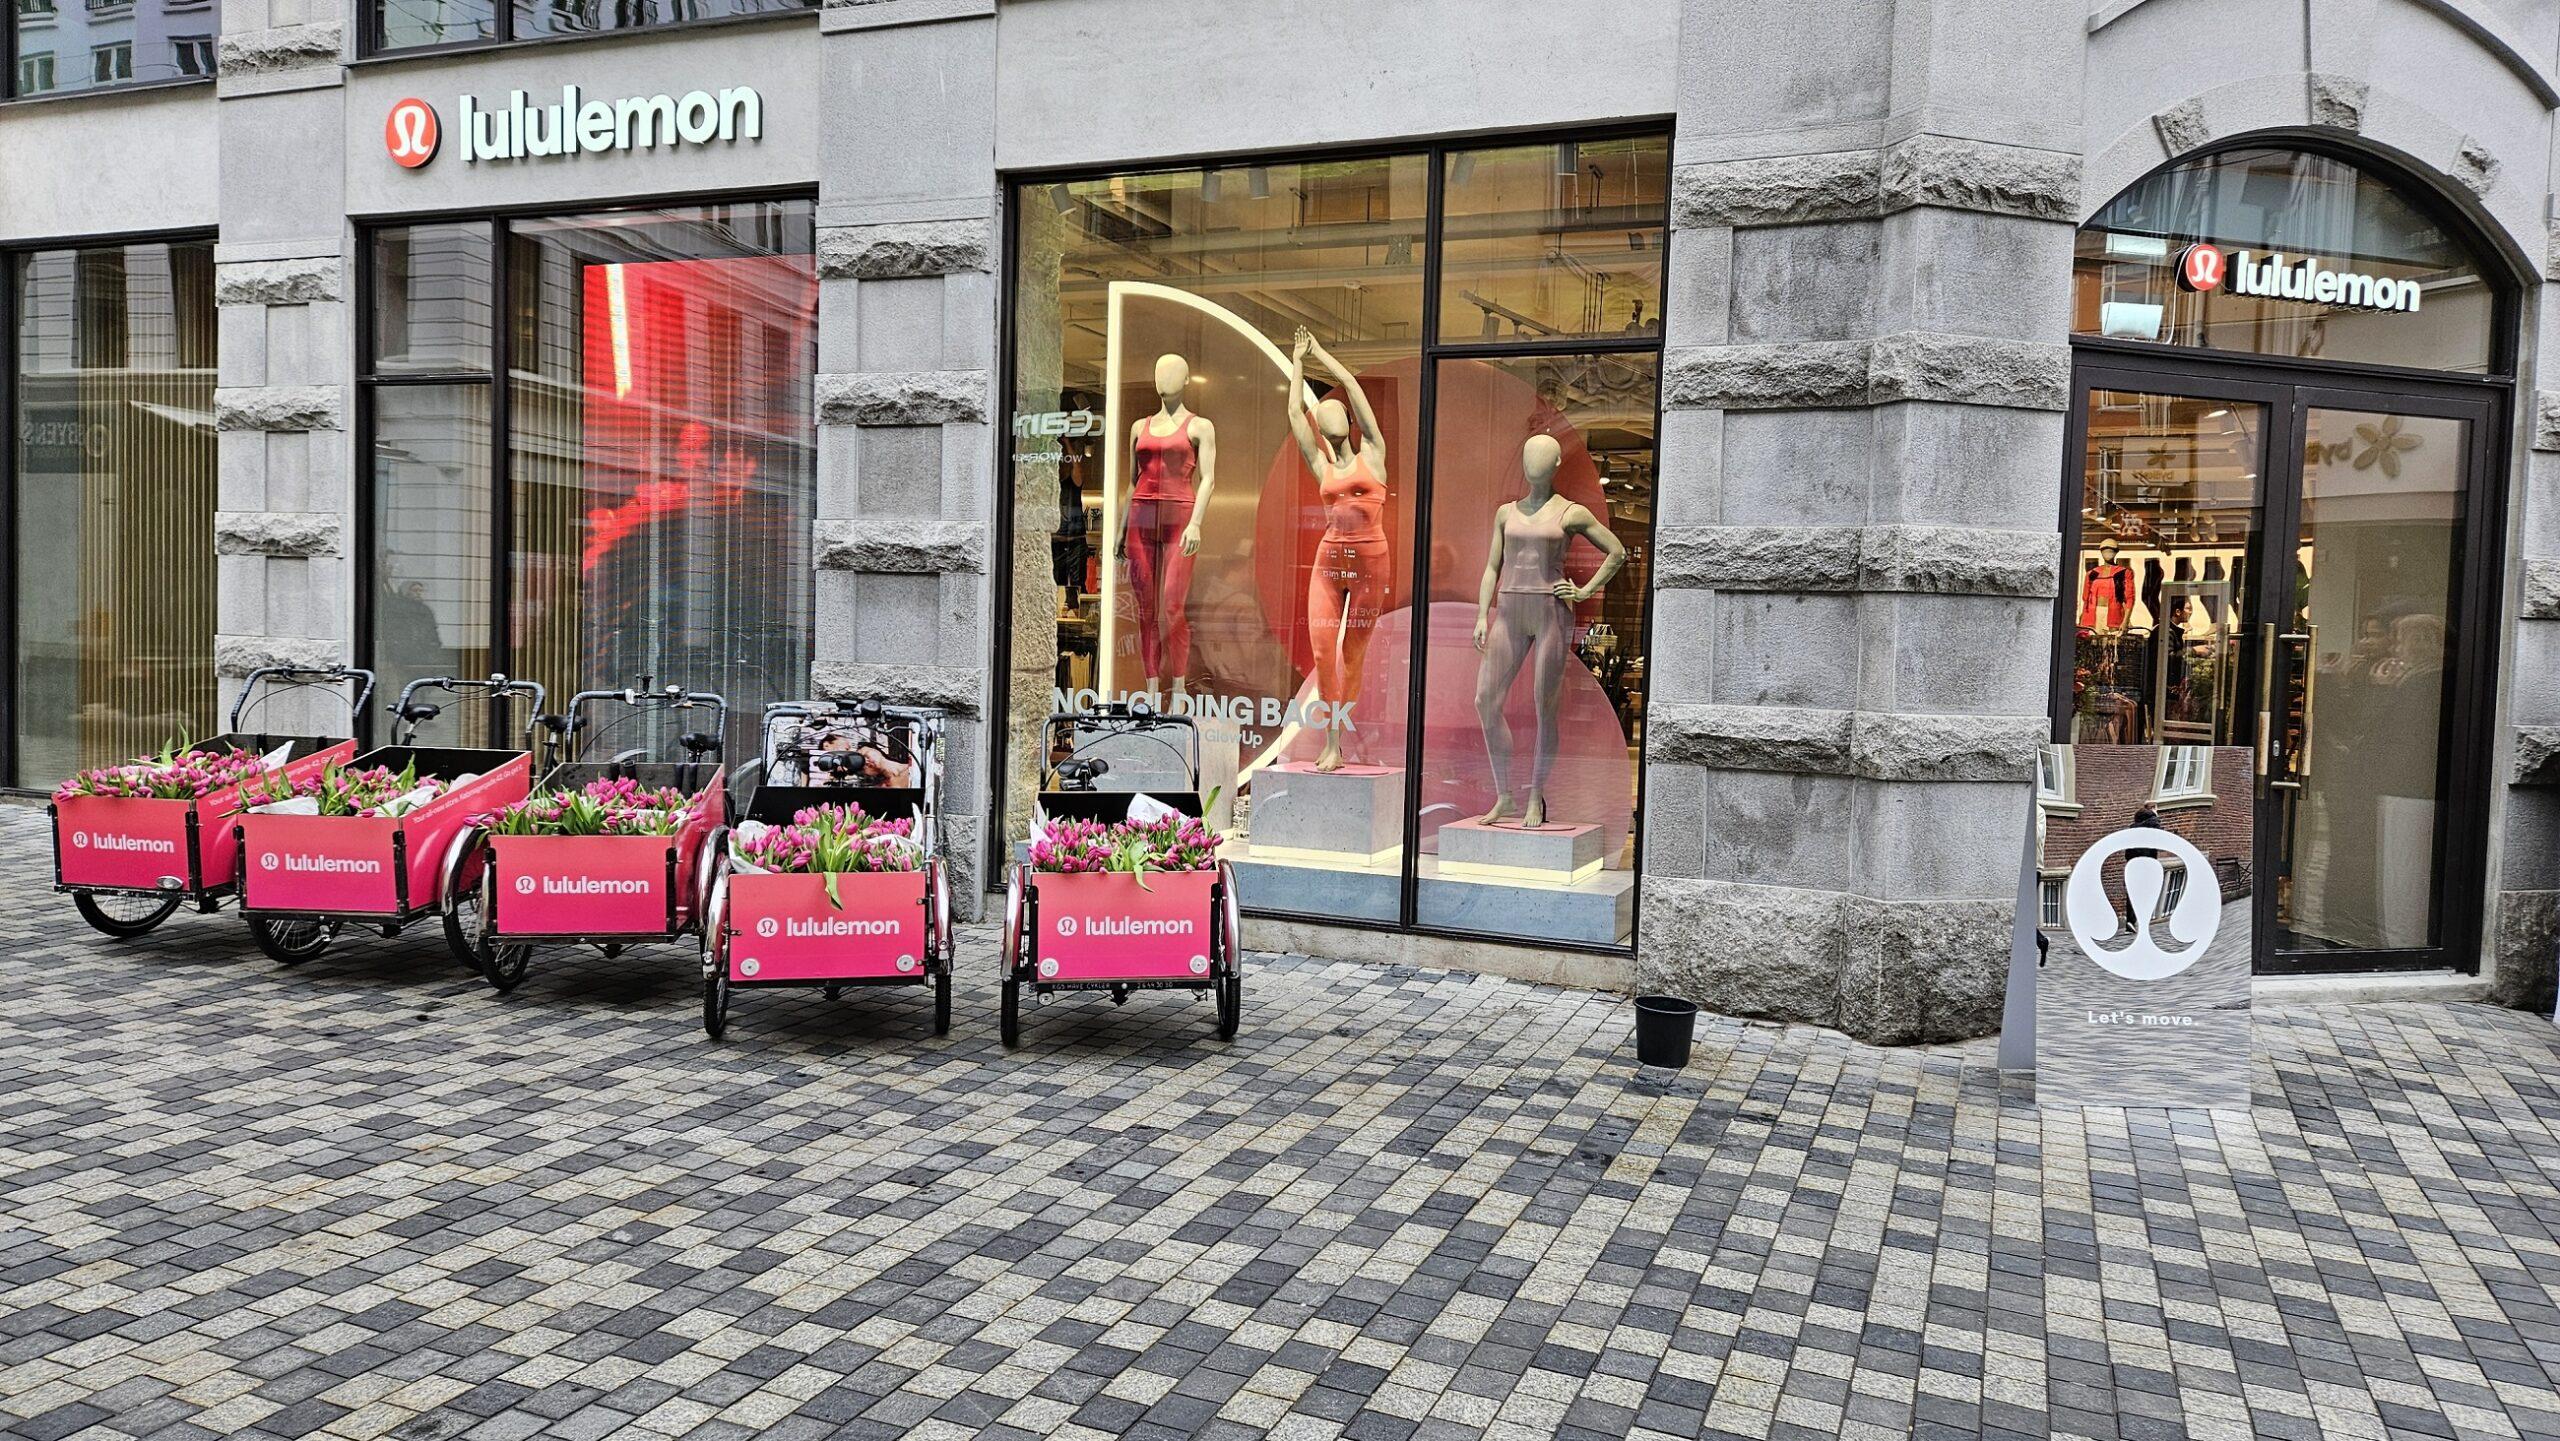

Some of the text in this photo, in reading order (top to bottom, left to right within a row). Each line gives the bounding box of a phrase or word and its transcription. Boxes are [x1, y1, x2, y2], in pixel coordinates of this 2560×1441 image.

[459, 84, 763, 162] lululemon
[2236, 250, 2421, 312] lululemon
[1052, 687, 1357, 732] NO HOLDING BACK
[93, 832, 174, 853] lululemon
[285, 853, 380, 873] lululemon
[543, 875, 649, 894] lululemon
[786, 916, 900, 937] lululemon
[1085, 915, 1193, 936] lululemon
[2088, 1010, 2200, 1026] Let's move.
